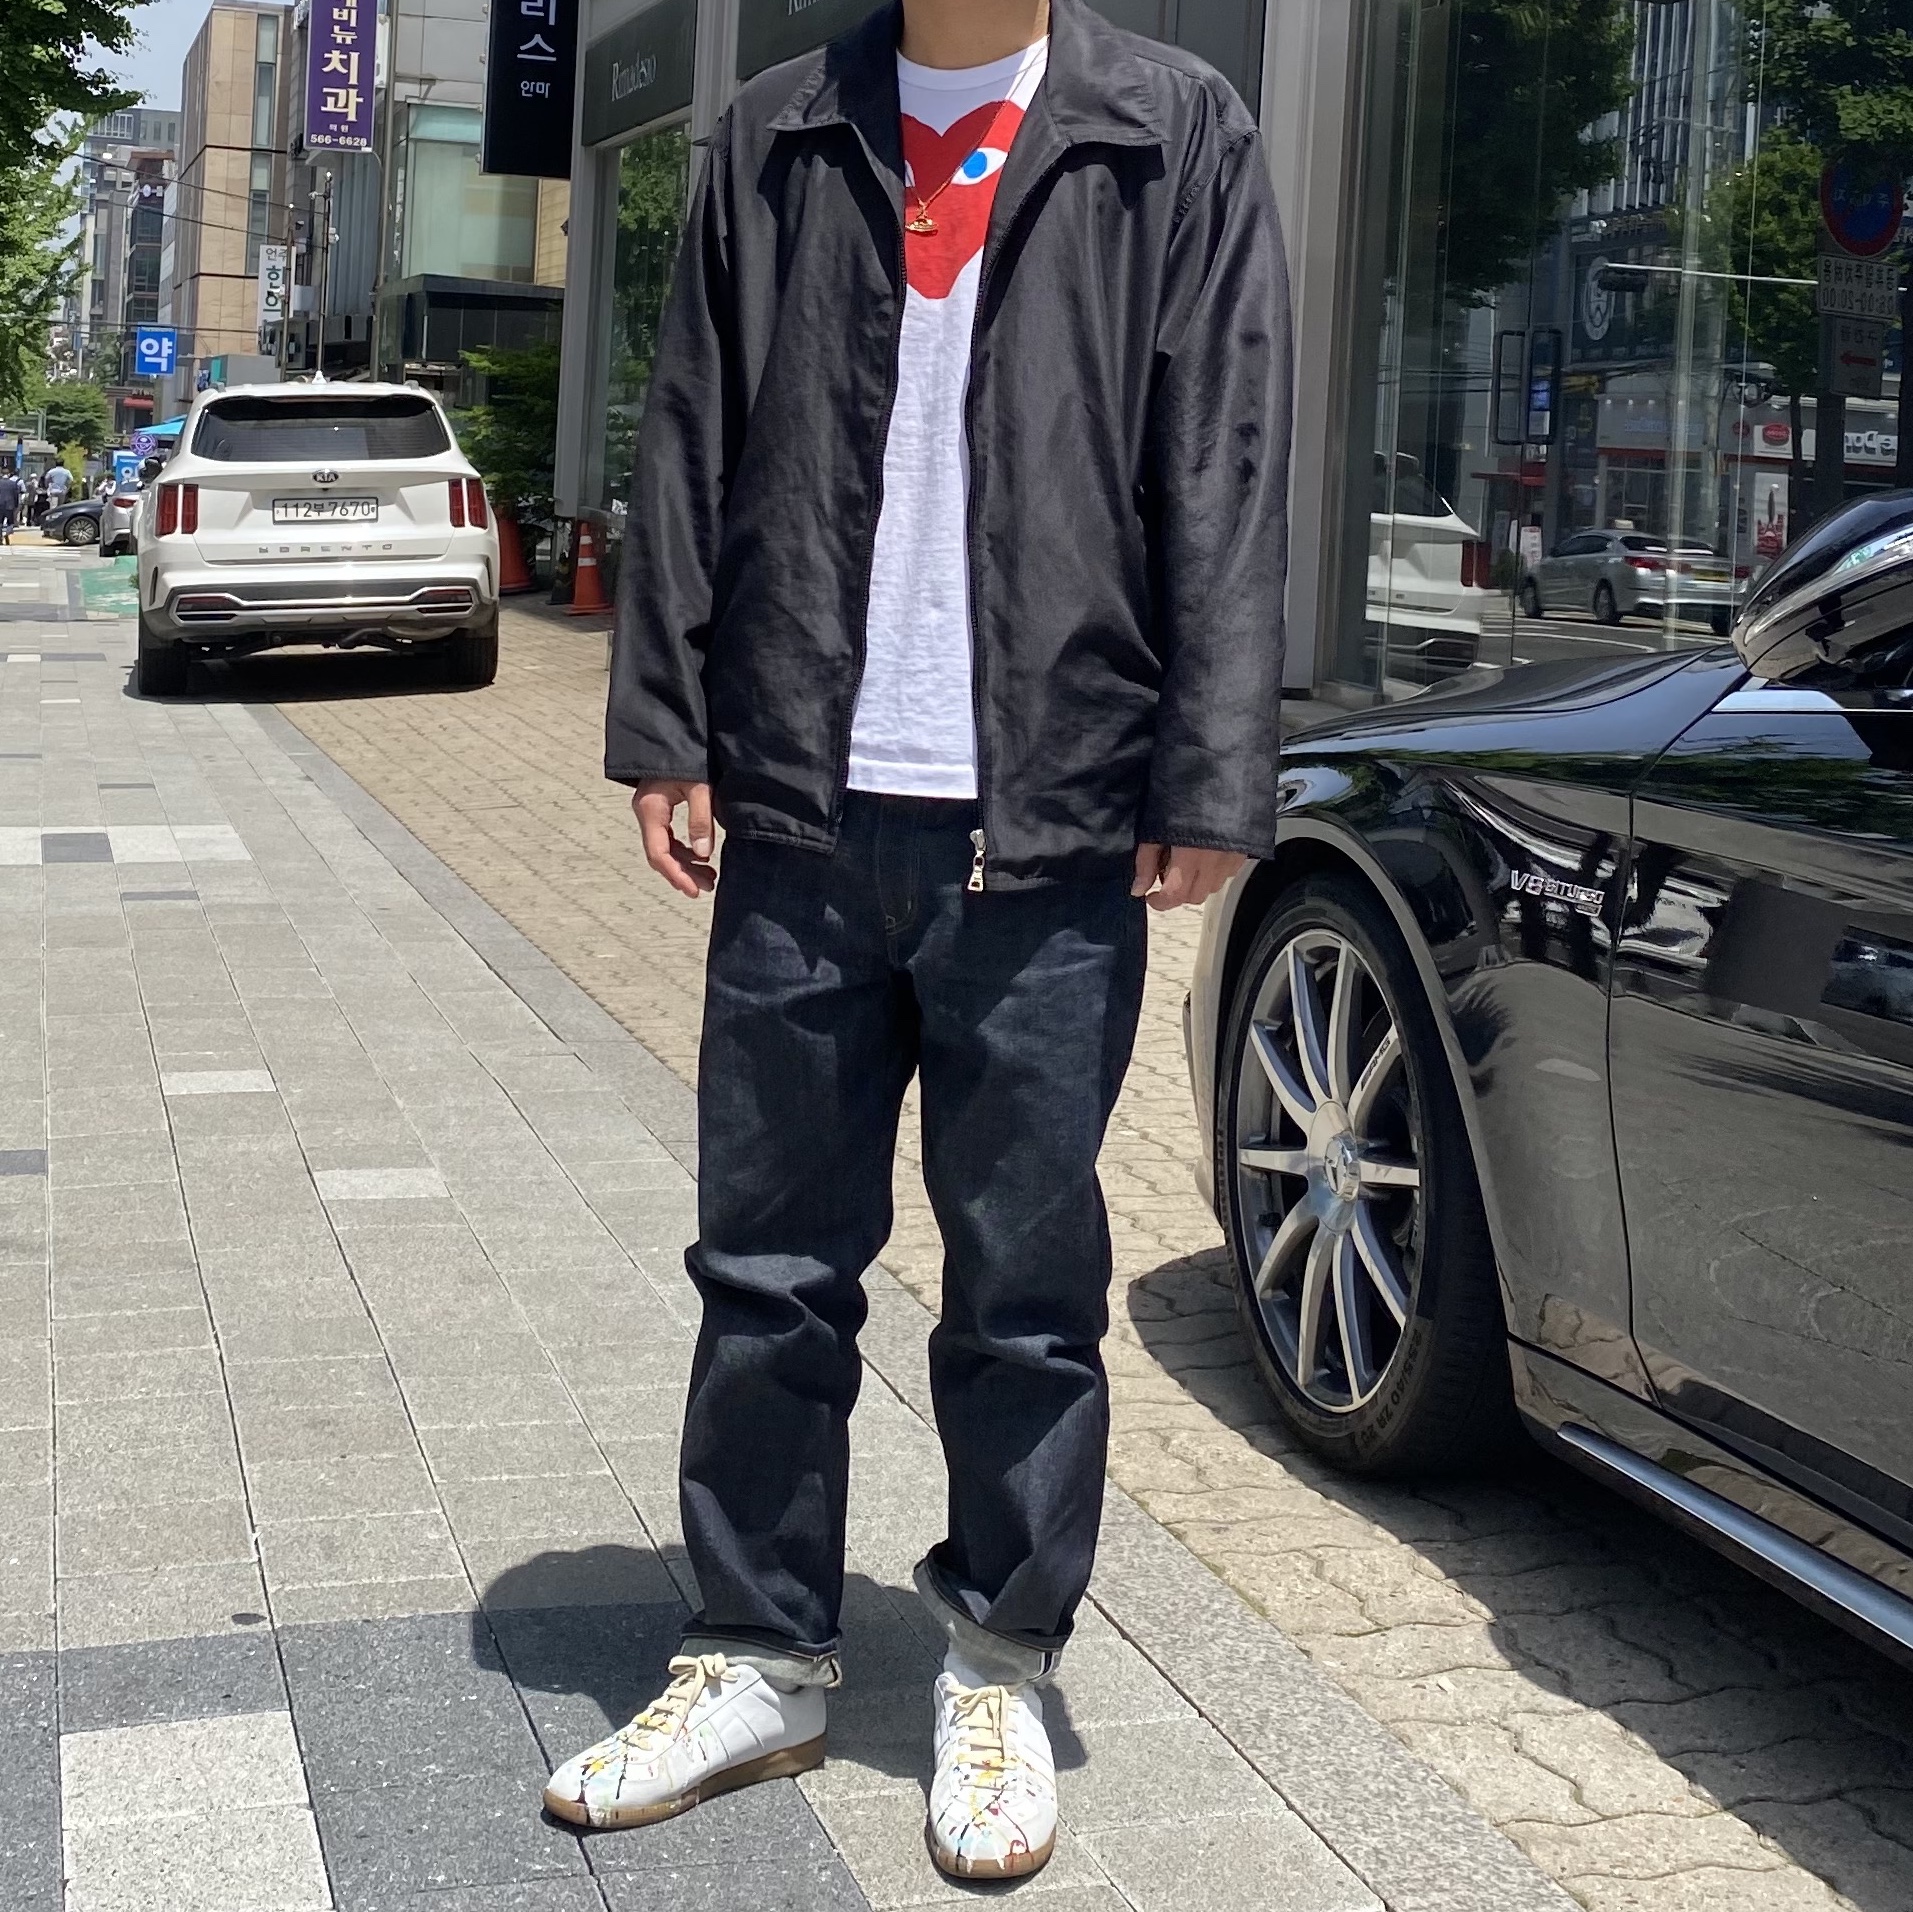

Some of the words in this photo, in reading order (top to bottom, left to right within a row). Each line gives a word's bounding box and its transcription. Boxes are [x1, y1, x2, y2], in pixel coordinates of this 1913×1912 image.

[331, 0, 358, 45] 비뉴
[321, 49, 364, 122] 치과
[520, 80, 551, 98] 안마
[140, 338, 173, 372] 약
[316, 471, 340, 482] KIA
